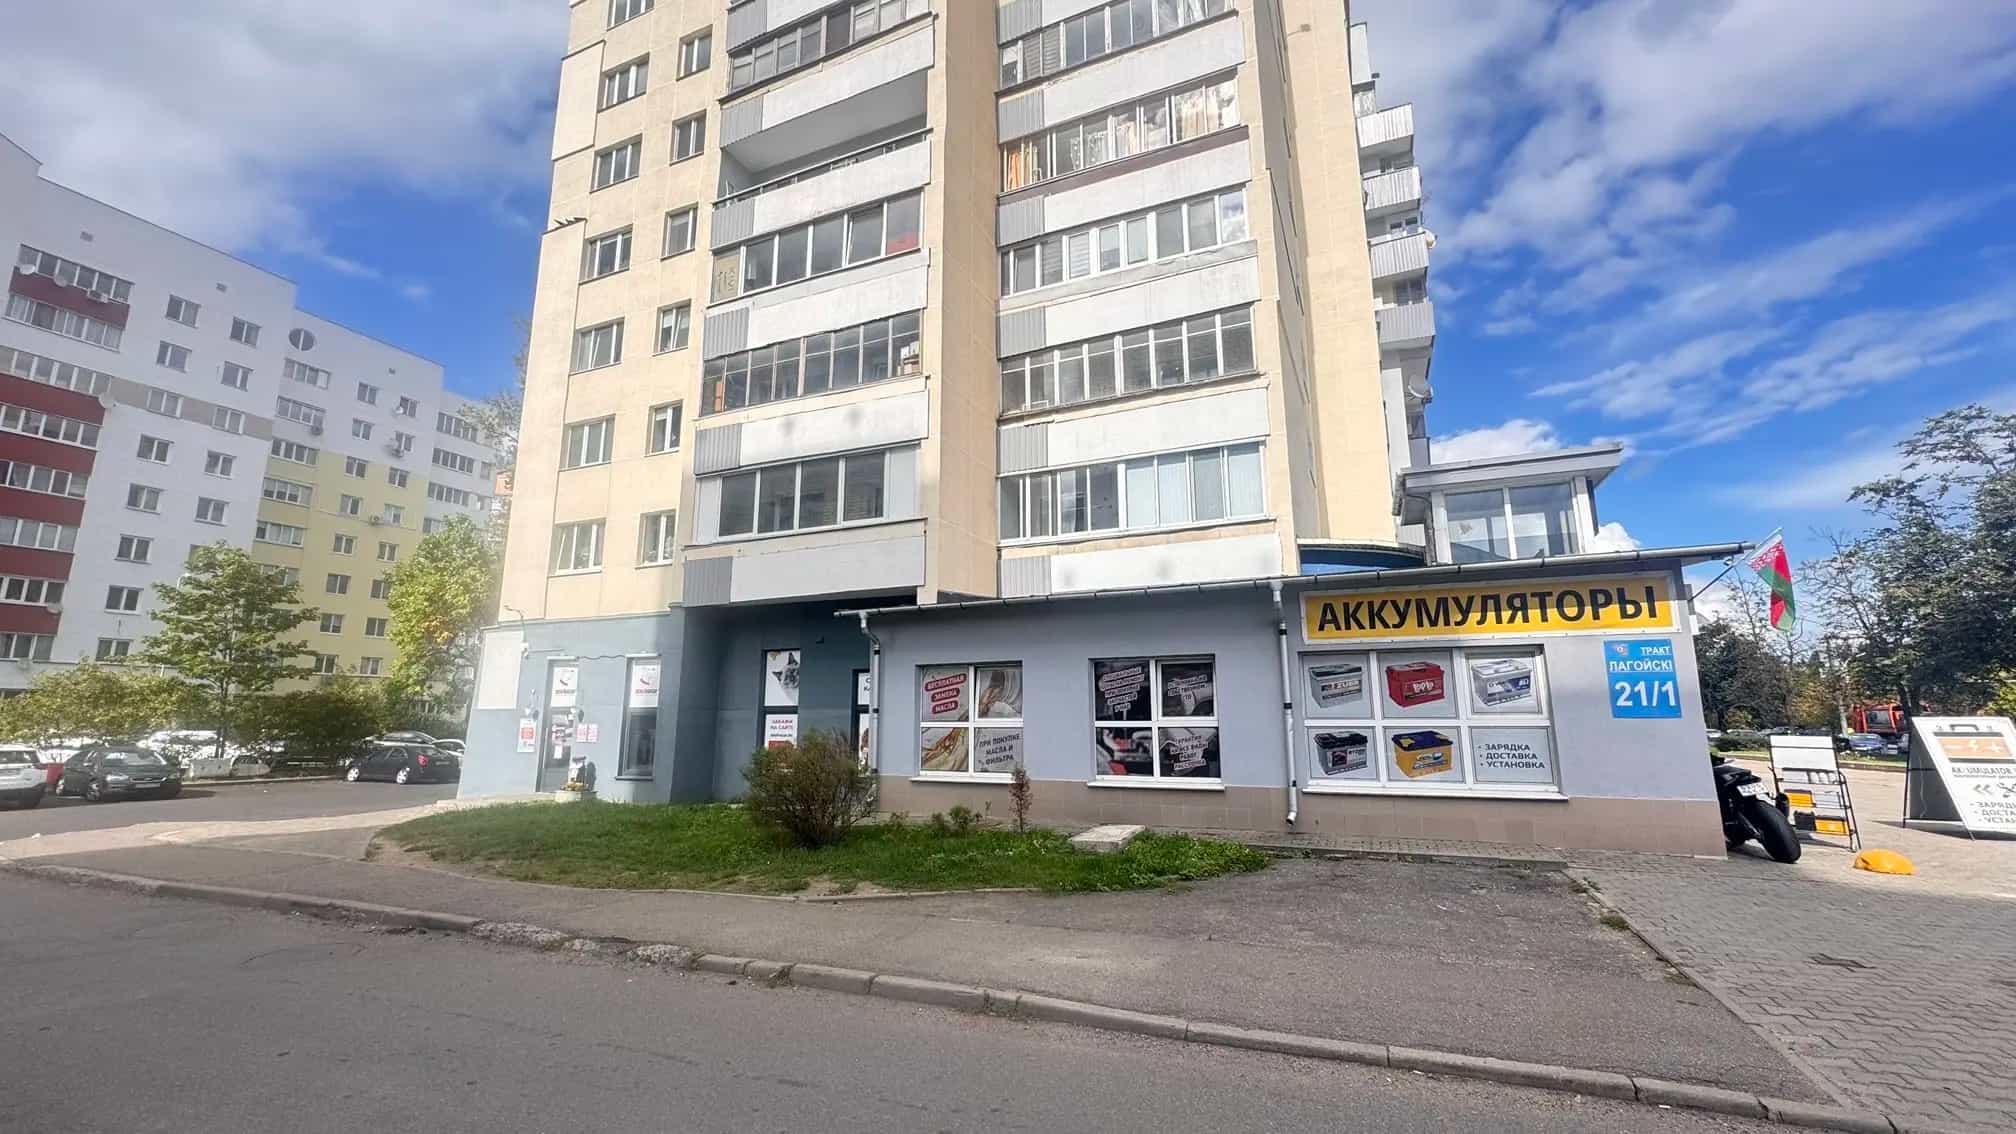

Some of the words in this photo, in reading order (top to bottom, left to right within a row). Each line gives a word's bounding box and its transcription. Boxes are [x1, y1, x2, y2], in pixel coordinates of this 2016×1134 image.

[1317, 585, 1658, 632] АККУМУЛЯТОРЫ
[1640, 646, 1671, 656] ТРАКТ
[927, 674, 965, 690] БЕСПЛАТНАЯ
[934, 689, 958, 701] ЗАМЕНА
[1614, 680, 1677, 707] 21/1
[935, 702, 956, 712] МАСЛА
[1485, 743, 1530, 752] ЗАРЯДКА
[1486, 752, 1538, 760] ДОСТАВКА
[1487, 761, 1545, 769] УСТАНОВКА
